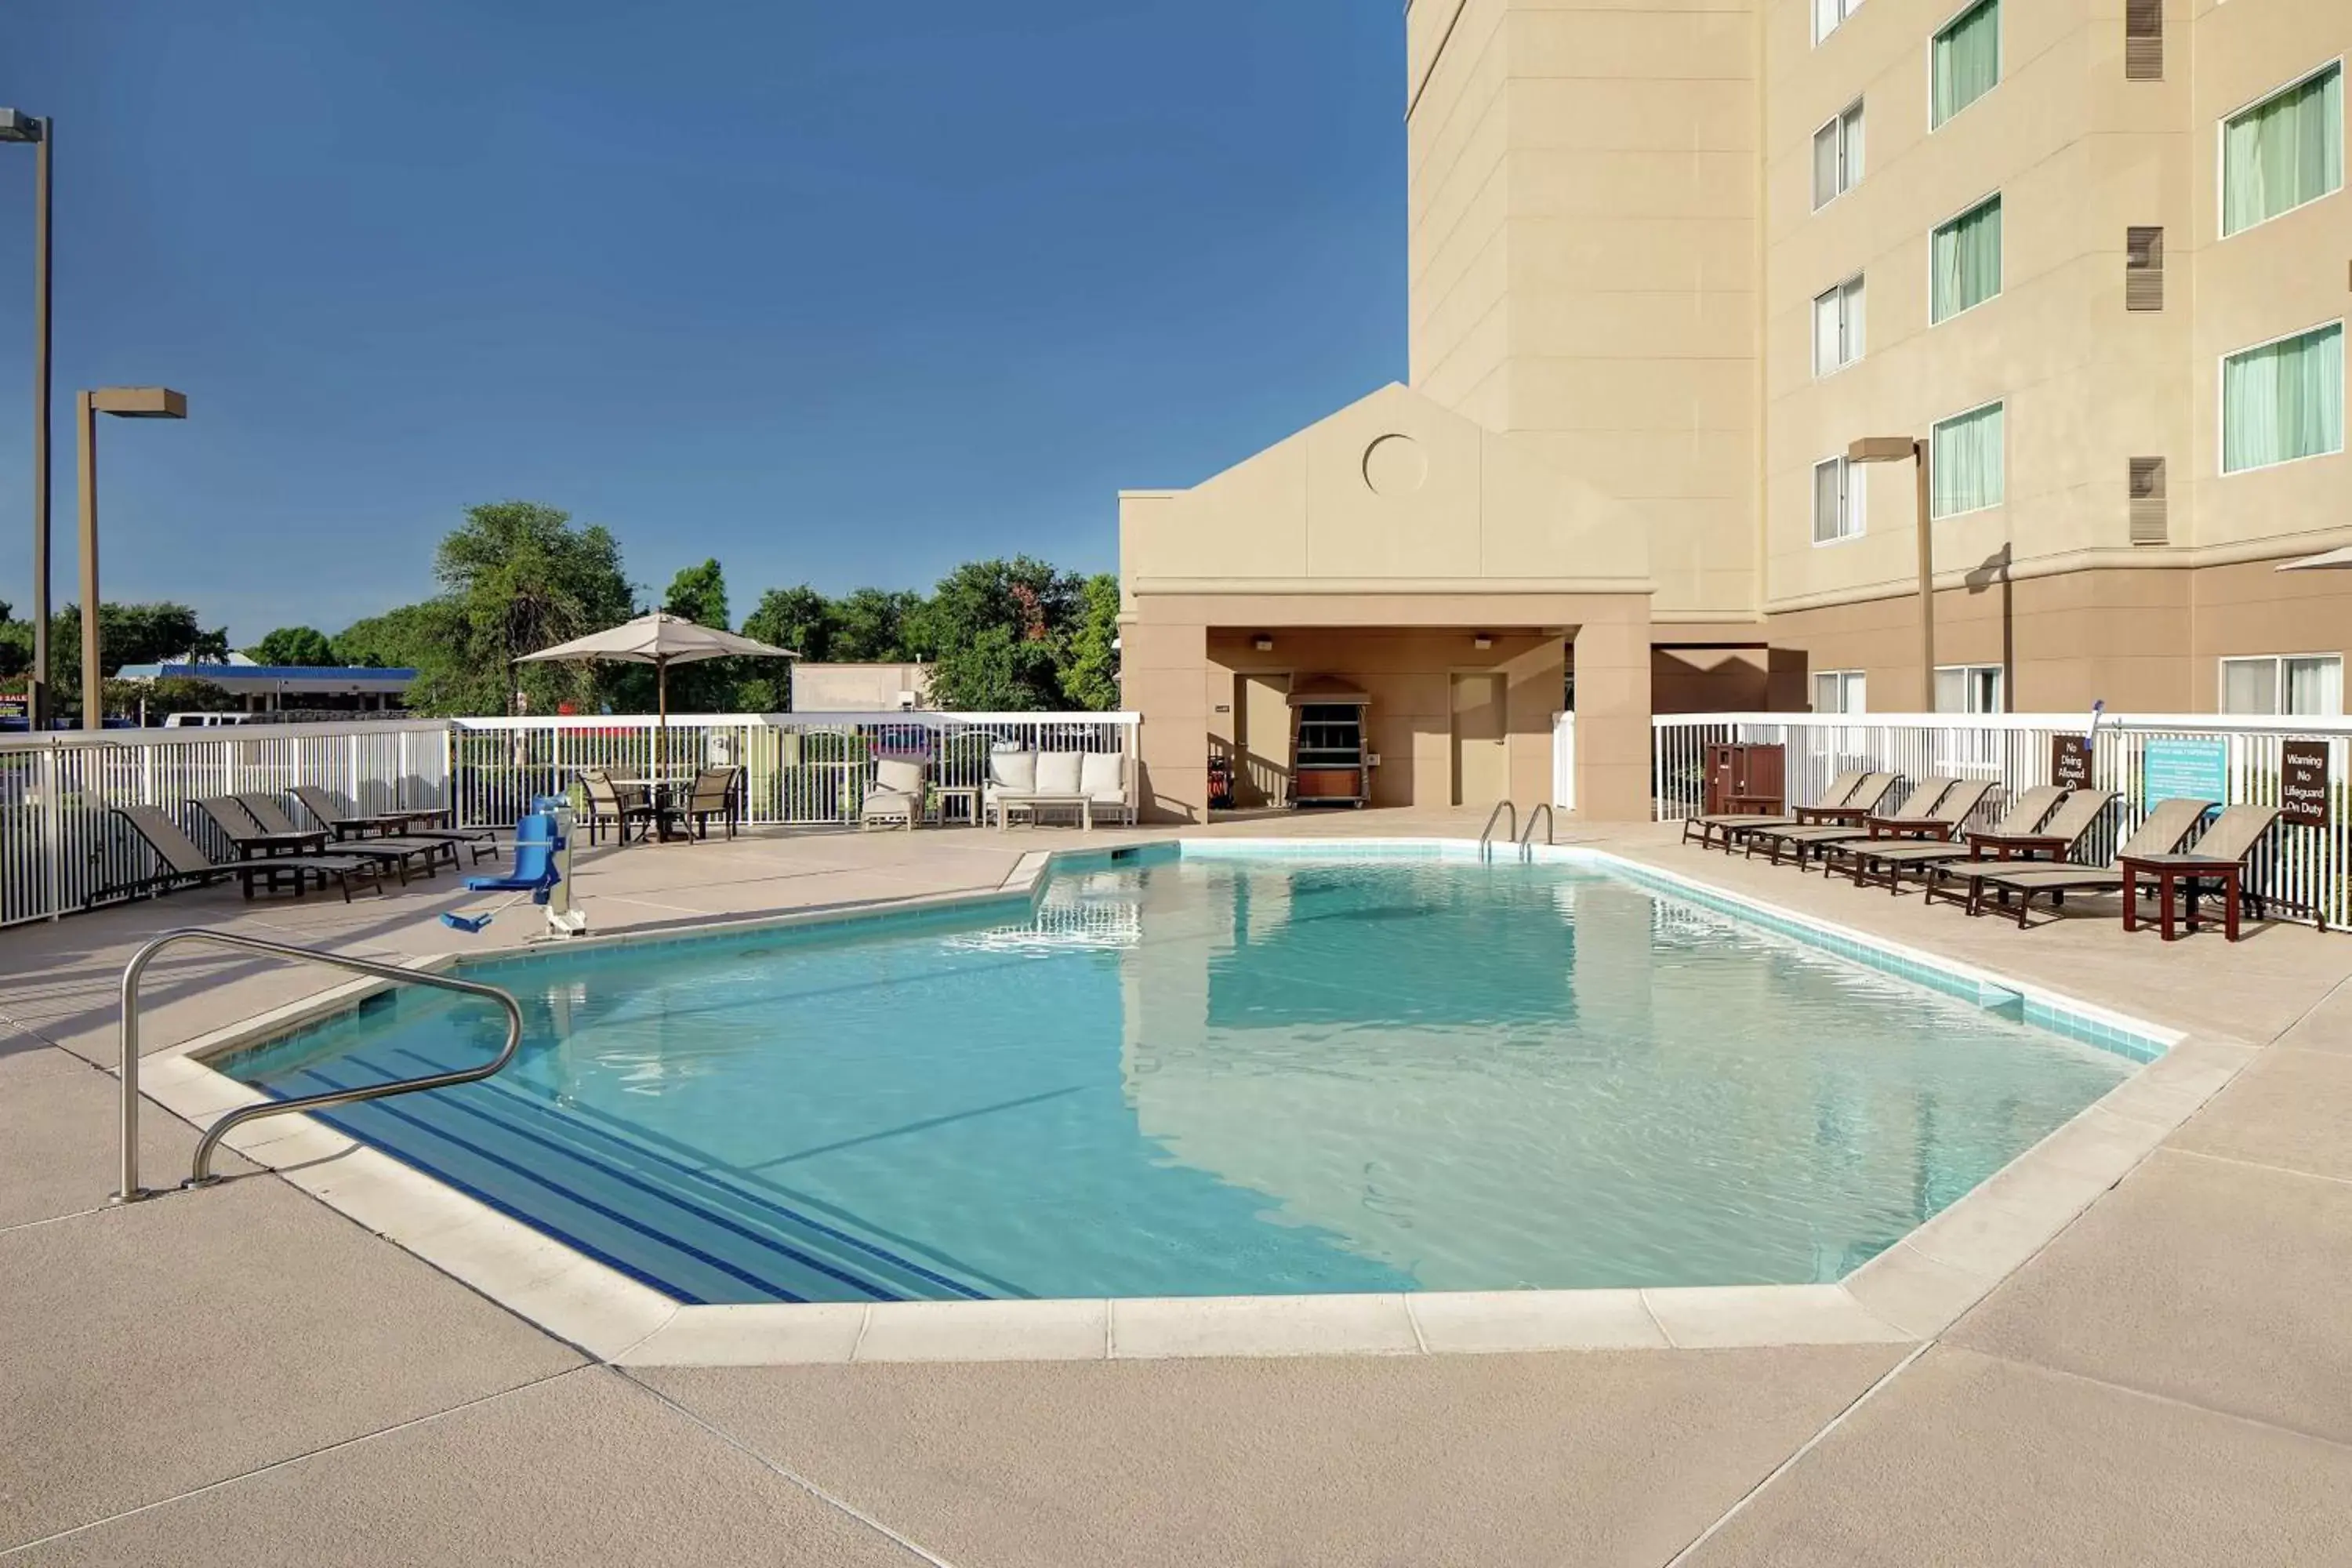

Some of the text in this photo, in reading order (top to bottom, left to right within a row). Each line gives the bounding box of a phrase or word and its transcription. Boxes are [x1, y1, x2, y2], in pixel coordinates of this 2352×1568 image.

[2066, 742, 2077, 753] No
[2287, 753, 2323, 768] Warning
[2058, 768, 2085, 779] Allowed
[2296, 769, 2311, 782] No
[2284, 785, 2325, 800] Lifeguard
[2286, 800, 2323, 817] On Duty
